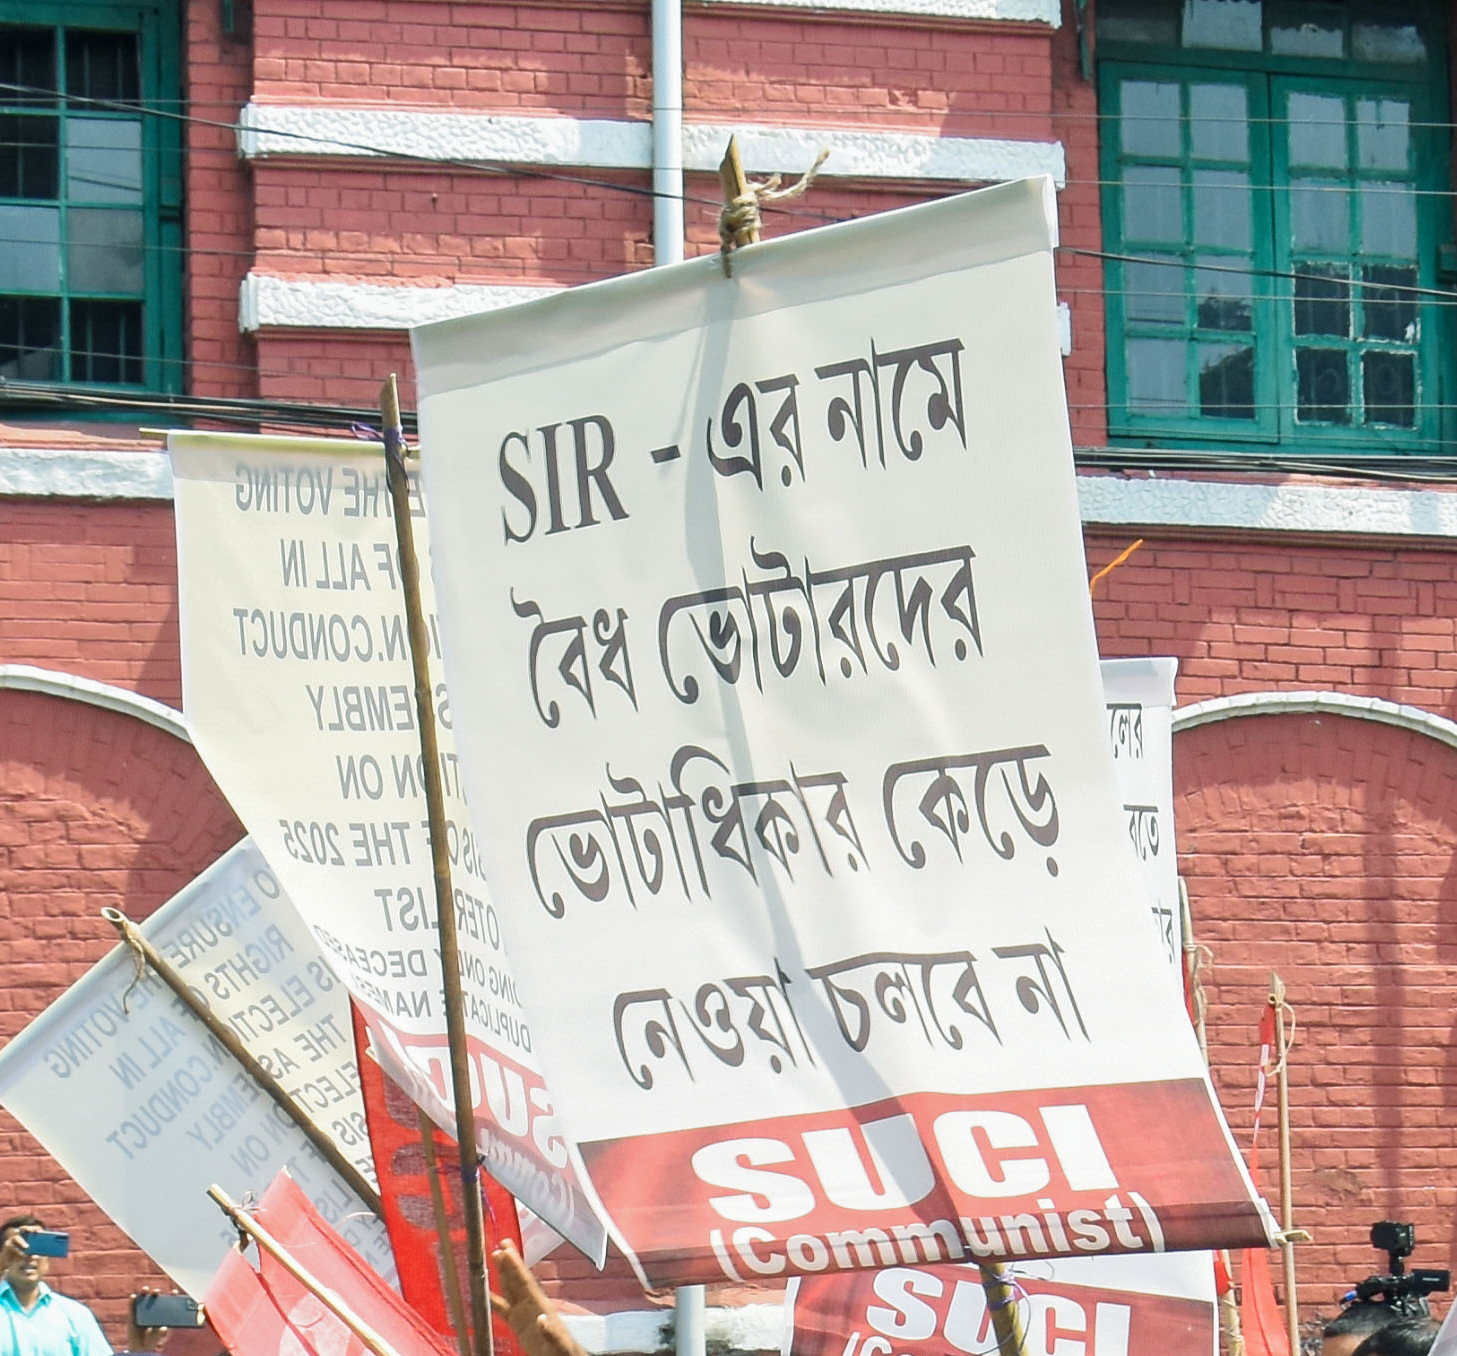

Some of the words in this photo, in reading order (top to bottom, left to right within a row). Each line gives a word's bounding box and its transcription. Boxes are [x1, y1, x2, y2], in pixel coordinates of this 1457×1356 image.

[498, 413, 630, 545] SIR
[706, 370, 804, 494] এর
[813, 336, 971, 474] নামে
[511, 586, 638, 730] বৈধ
[656, 535, 987, 707] ভোটারদের
[526, 742, 873, 921] ভোটাধিকার
[882, 741, 1062, 878] কেড়ে
[612, 953, 800, 1092] নেওয়া
[804, 946, 990, 1055] চলবে
[991, 926, 1094, 1044] না
[692, 1101, 1123, 1228] SUCI
[709, 1189, 1167, 1284] (Communist)
